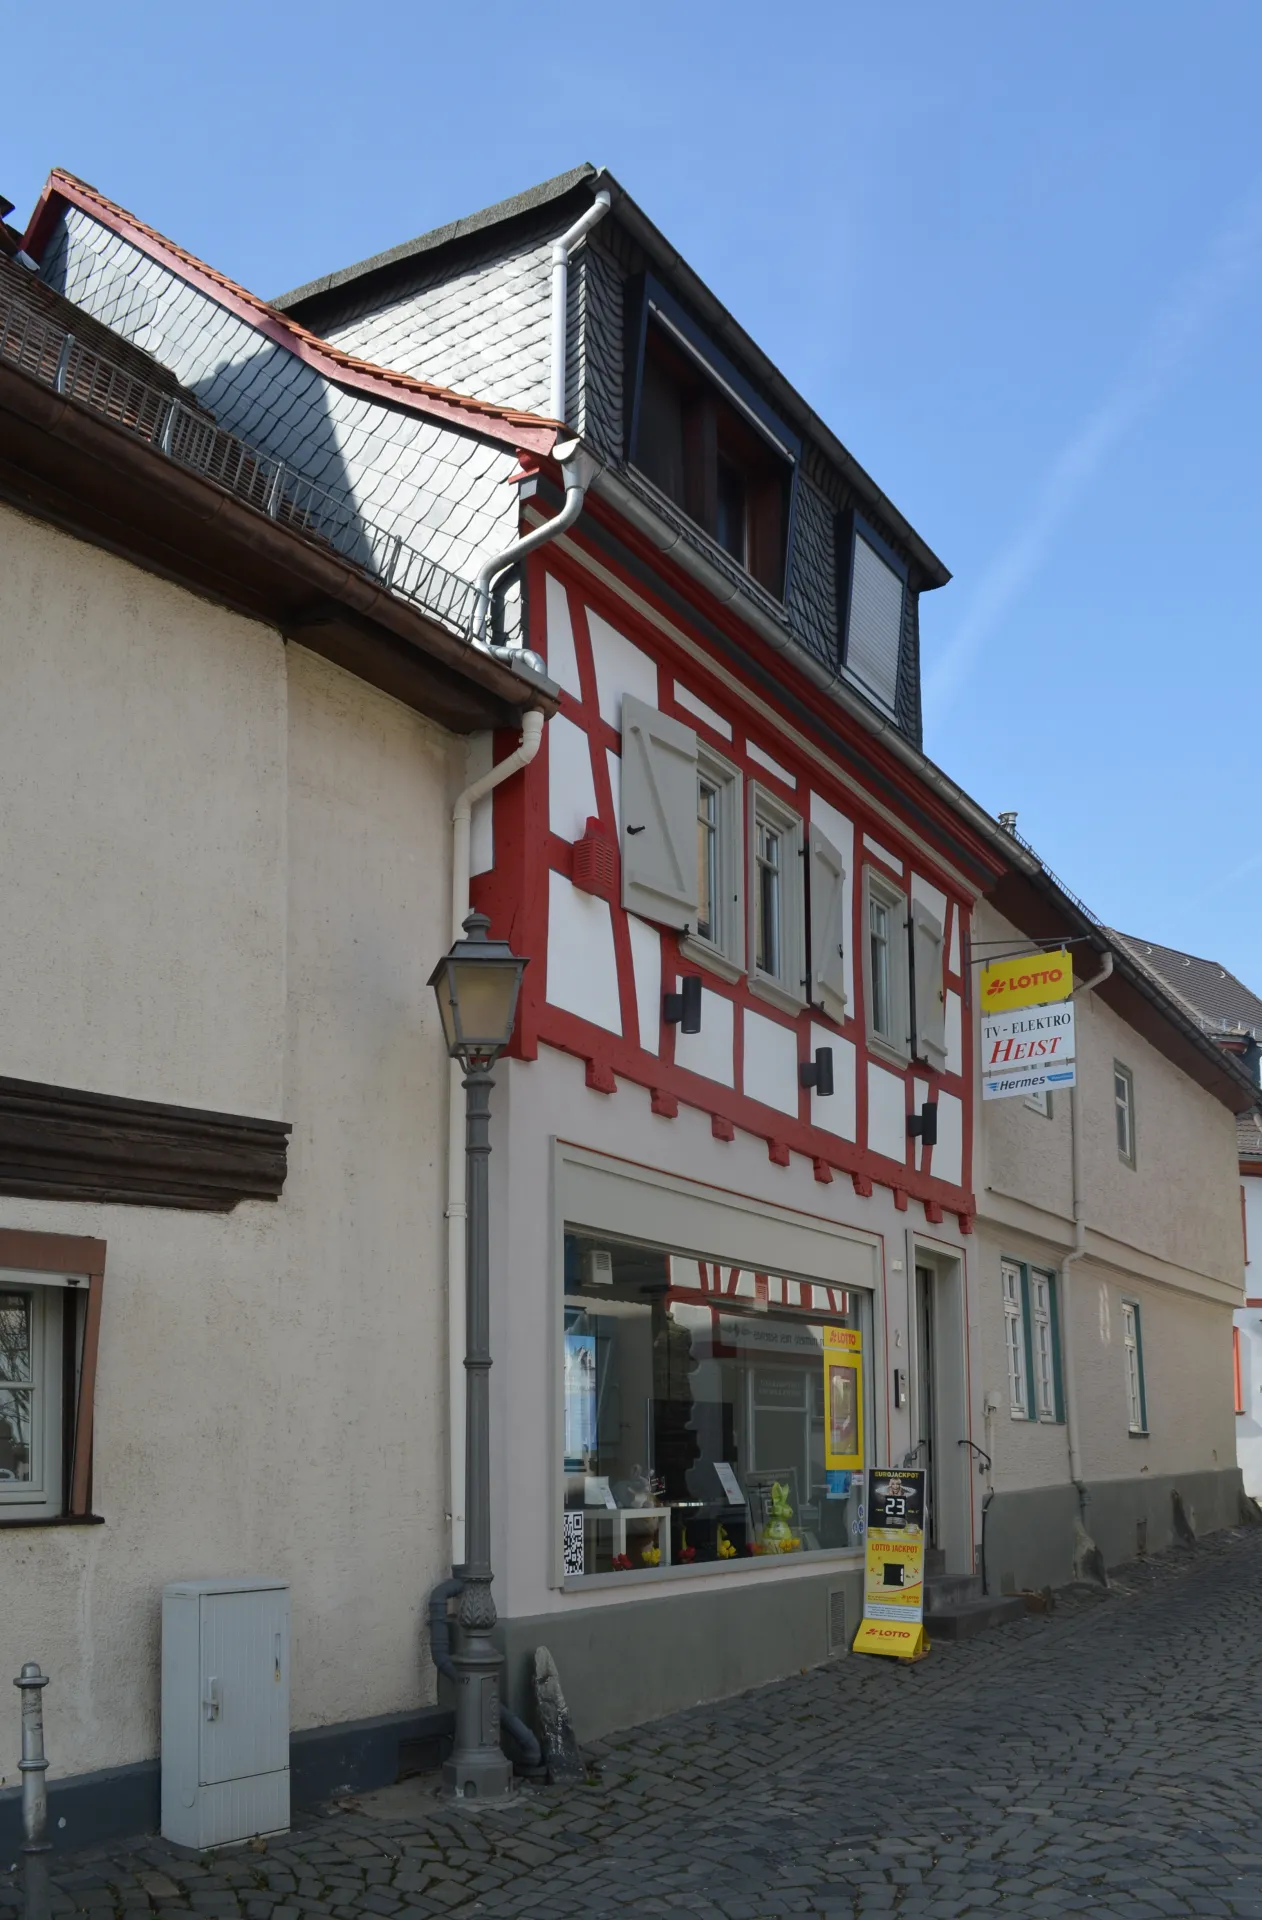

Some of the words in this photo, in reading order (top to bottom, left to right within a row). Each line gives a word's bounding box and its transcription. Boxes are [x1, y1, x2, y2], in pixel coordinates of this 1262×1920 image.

[1009, 968, 1063, 990] LOTTO
[984, 1025, 1000, 1039] TV
[1012, 1013, 1071, 1034] ELEKTRO
[989, 1036, 1062, 1064] HEIST
[1000, 1076, 1046, 1091] Hermes
[838, 1331, 856, 1345] LOTTO
[885, 1498, 905, 1515] 23
[871, 1543, 890, 1551] LOTTO
[892, 1544, 918, 1554] JACKPOT
[879, 1629, 911, 1638] LOTTO
